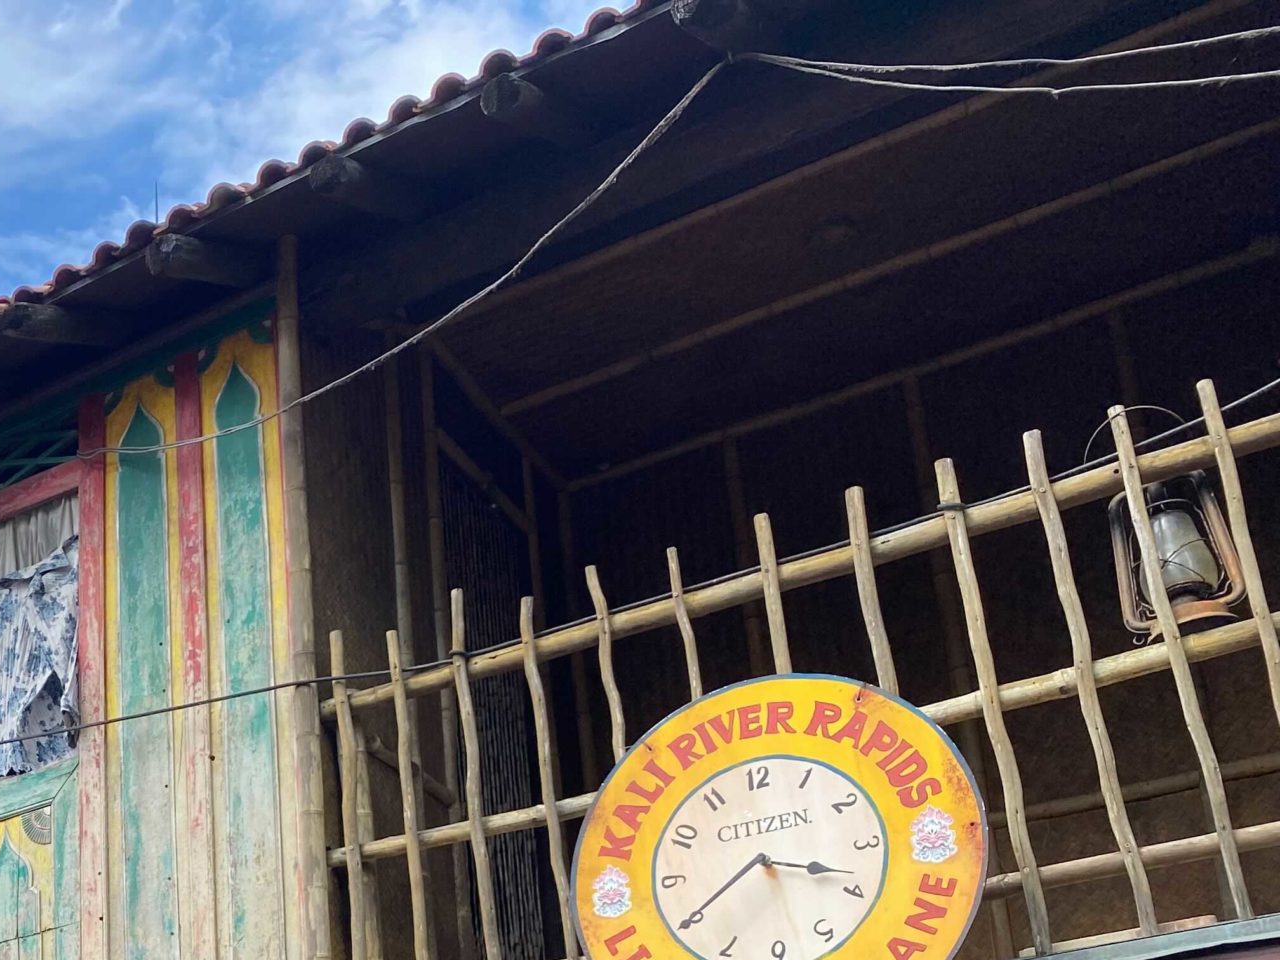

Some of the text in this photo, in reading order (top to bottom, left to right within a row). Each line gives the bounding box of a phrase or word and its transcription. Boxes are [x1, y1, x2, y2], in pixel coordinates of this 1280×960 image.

[598, 700, 942, 861] KALI RIVER RAPIDS
[745, 766, 770, 791] 12
[798, 767, 813, 790] 1
[702, 787, 726, 812] 11
[831, 793, 858, 814] 2
[671, 823, 698, 850] 10
[853, 834, 880, 851] 3
[661, 874, 686, 889] 9
[843, 884, 865, 899] 4
[813, 918, 835, 943] 5
[719, 935, 738, 958] 7
